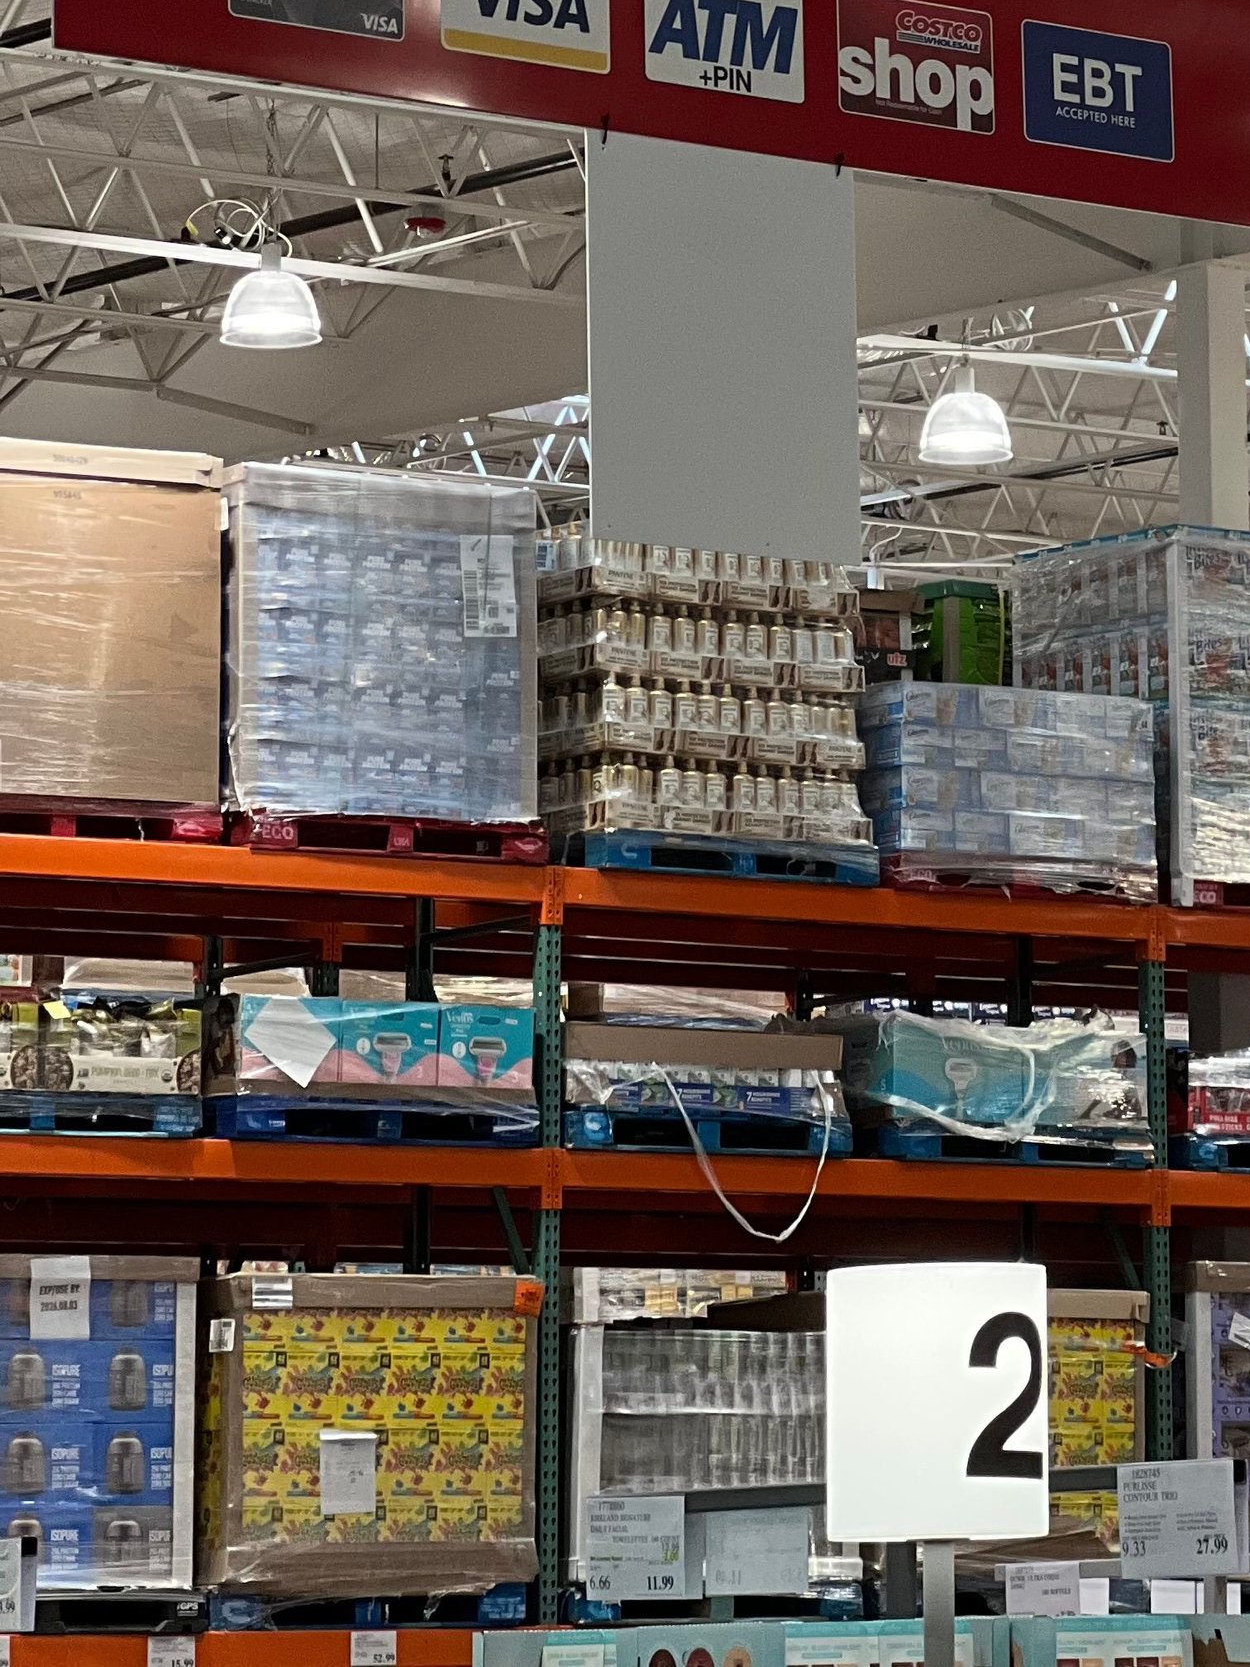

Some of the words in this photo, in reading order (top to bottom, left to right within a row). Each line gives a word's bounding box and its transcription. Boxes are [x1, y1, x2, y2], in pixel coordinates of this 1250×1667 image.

[360, 13, 399, 34] VISA
[896, 10, 983, 43] COSTCO
[924, 36, 980, 53] WHOLESALE
[700, 66, 752, 93] +PIN
[840, 37, 994, 131] shop
[1053, 53, 1142, 112] EBT
[1056, 106, 1107, 124] ACCEPTED
[1111, 114, 1136, 128] HERE
[966, 1311, 1043, 1479] 2
[1123, 1492, 1158, 1502] CONTOUR
[1122, 1540, 1146, 1557] 9.33
[1196, 1535, 1229, 1555] 27.99
[590, 1575, 611, 1591] 6.66
[647, 1575, 675, 1591] 11.99
[373, 1653, 395, 1664] 52.99
